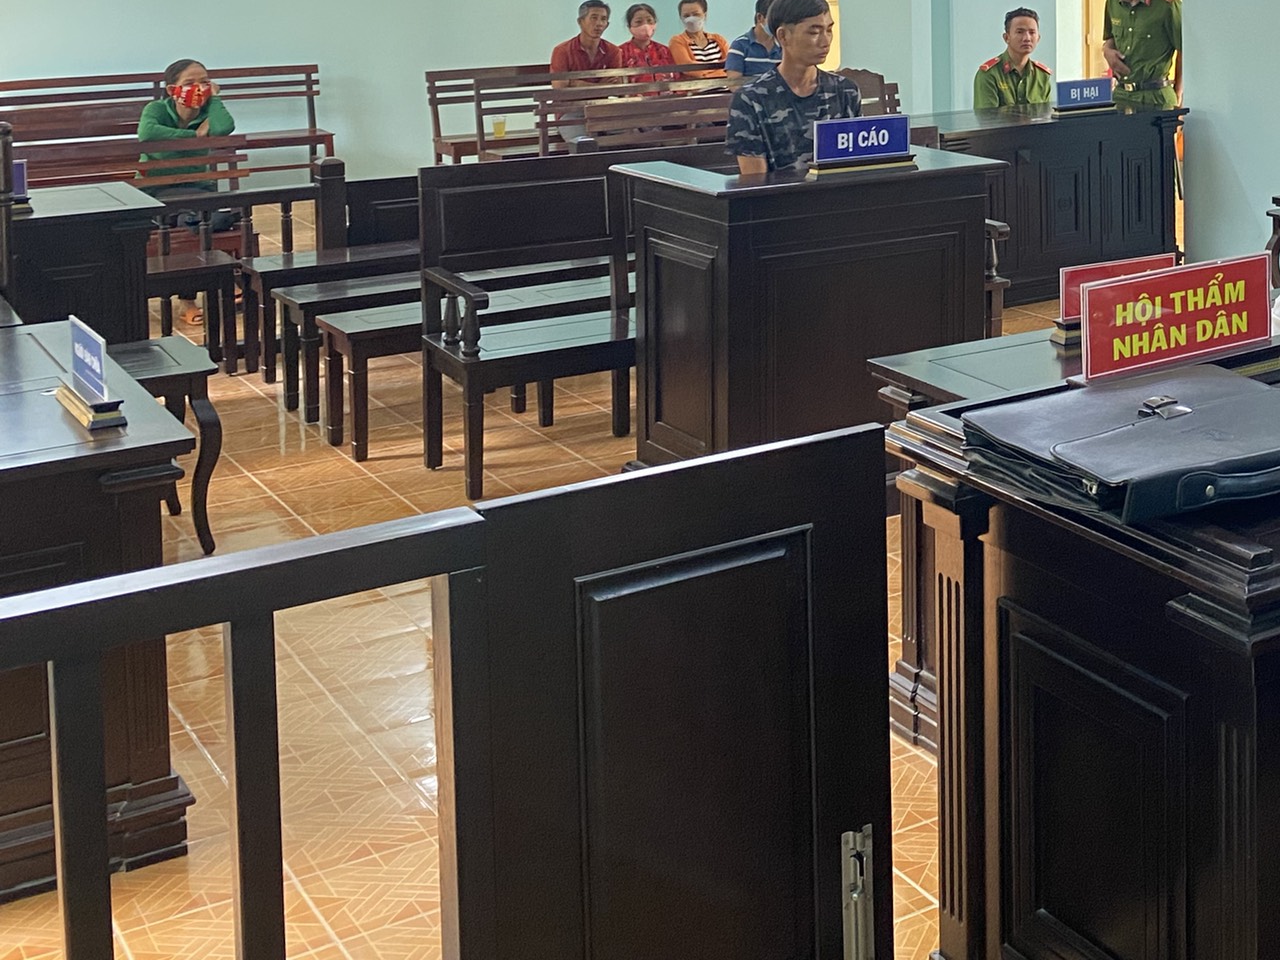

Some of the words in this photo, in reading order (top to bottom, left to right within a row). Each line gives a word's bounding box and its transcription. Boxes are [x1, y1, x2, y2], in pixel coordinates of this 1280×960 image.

[1070, 87, 1080, 101] BỊ
[1083, 86, 1099, 100] HẠI
[837, 132, 854, 152] BỊ
[857, 126, 889, 147] CÁO
[1115, 292, 1162, 328] HỘI
[1169, 272, 1246, 315] THẨM
[1112, 323, 1187, 361] NHÂN
[1196, 309, 1248, 343] DÂN
